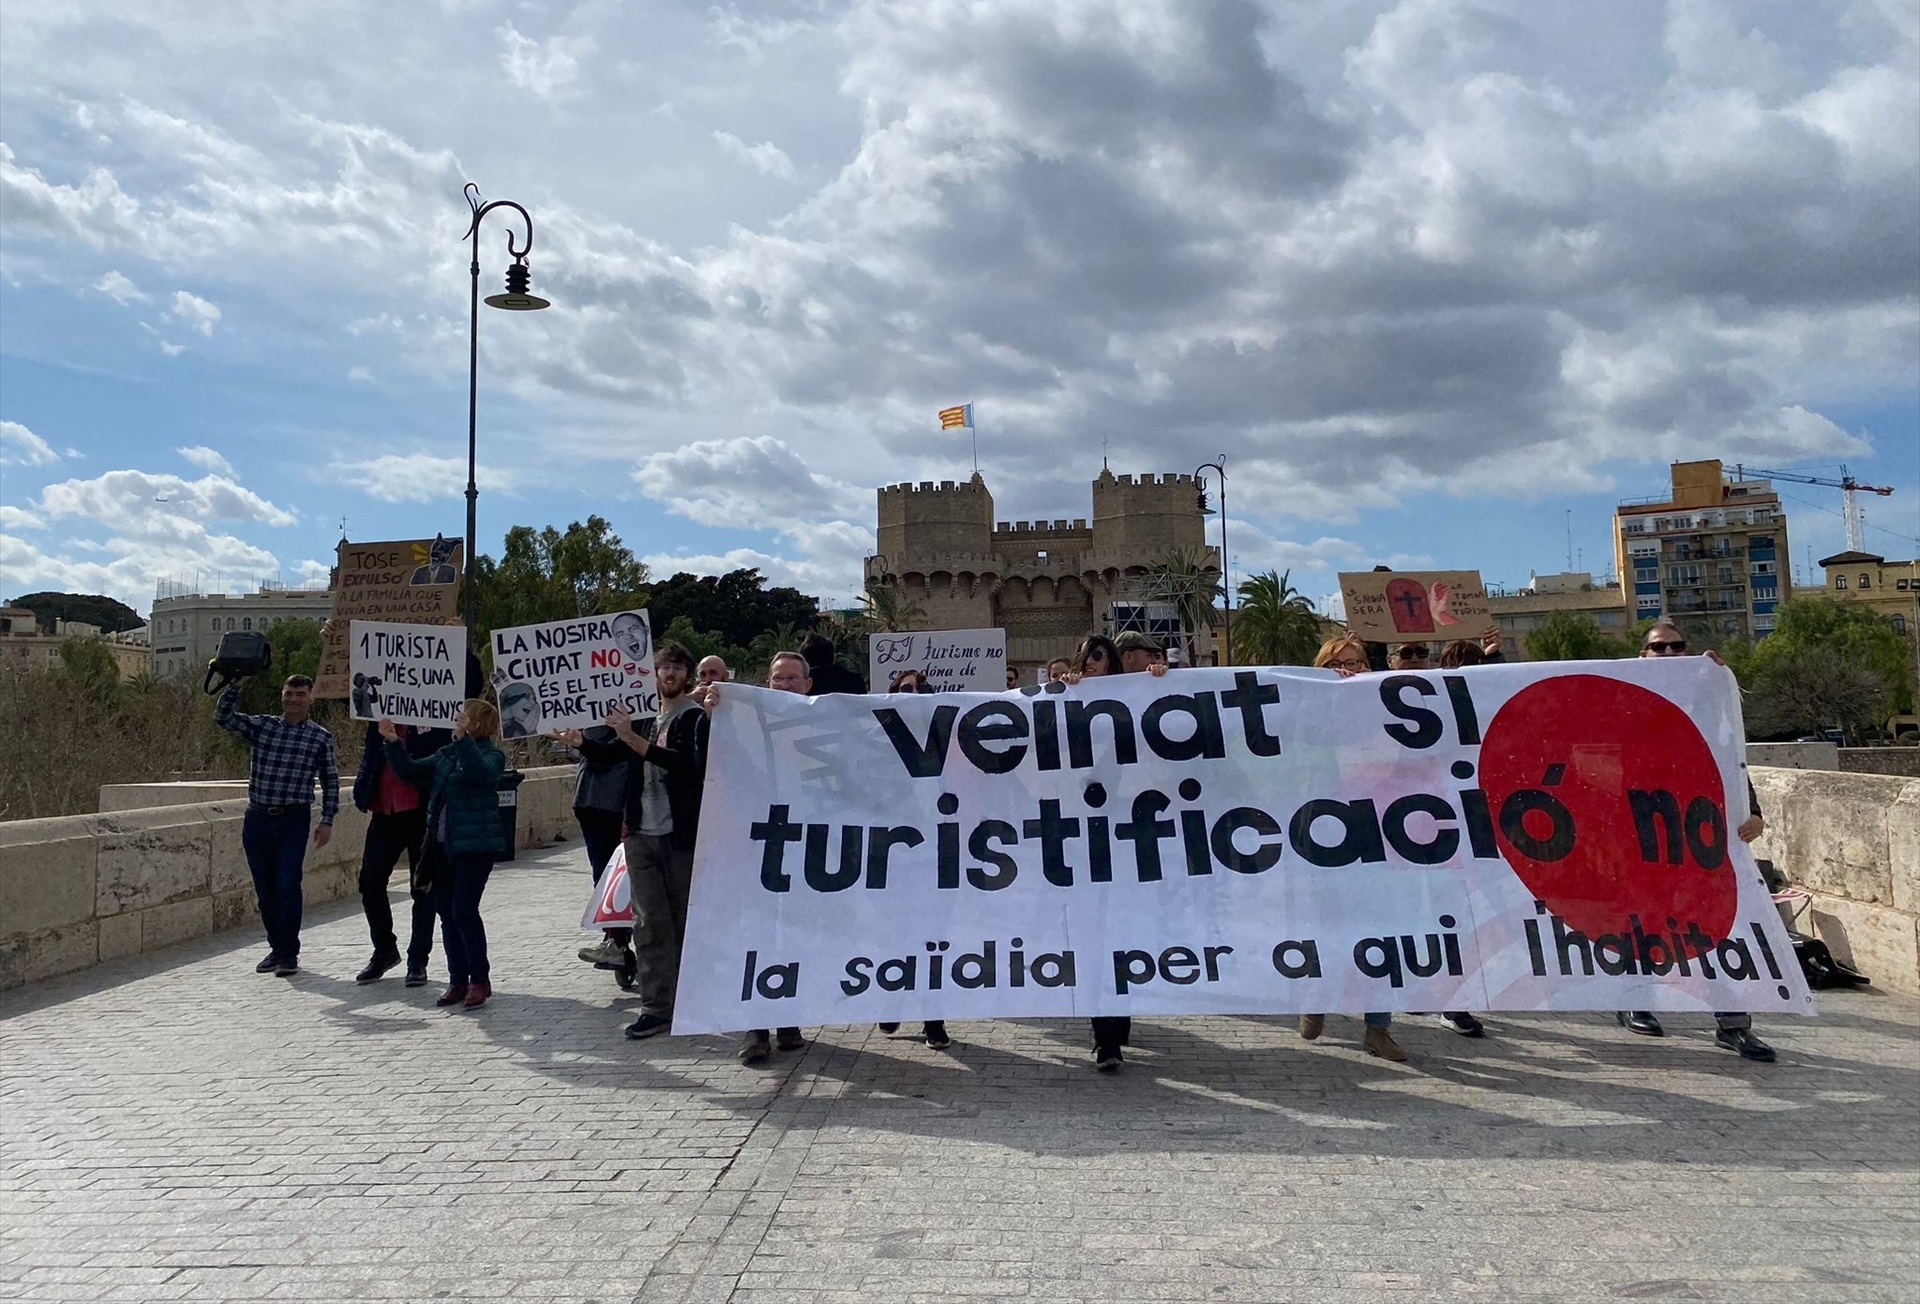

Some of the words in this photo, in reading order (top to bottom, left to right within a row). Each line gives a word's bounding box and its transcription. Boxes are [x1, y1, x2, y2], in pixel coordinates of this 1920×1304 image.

[350, 551, 399, 571] JOSE
[342, 570, 407, 588] EXPULSÓ
[340, 591, 347, 602] A
[351, 590, 363, 603] LA
[415, 590, 444, 601] QUE
[367, 604, 383, 615] EN
[385, 603, 407, 615] UNA
[409, 601, 441, 613] CASA
[360, 632, 369, 659] 1
[497, 633, 528, 655] LA
[535, 620, 612, 649] NOSTRA
[922, 636, 982, 660] turisme
[985, 646, 1004, 659] no
[591, 648, 621, 669] NO
[960, 661, 977, 676] de
[422, 668, 455, 686] UNA
[538, 680, 560, 698] ÉS
[566, 678, 588, 694] EL
[589, 671, 624, 690] TEU
[379, 692, 419, 717] VEÏNA
[541, 694, 587, 719] PARC
[749, 763, 1578, 893] turistificació
[1626, 788, 1728, 871] no
[741, 950, 800, 1001] la
[840, 936, 1076, 996] saïdia
[1113, 944, 1235, 995] per
[1272, 939, 1322, 979] a
[1353, 914, 1464, 988] qui
